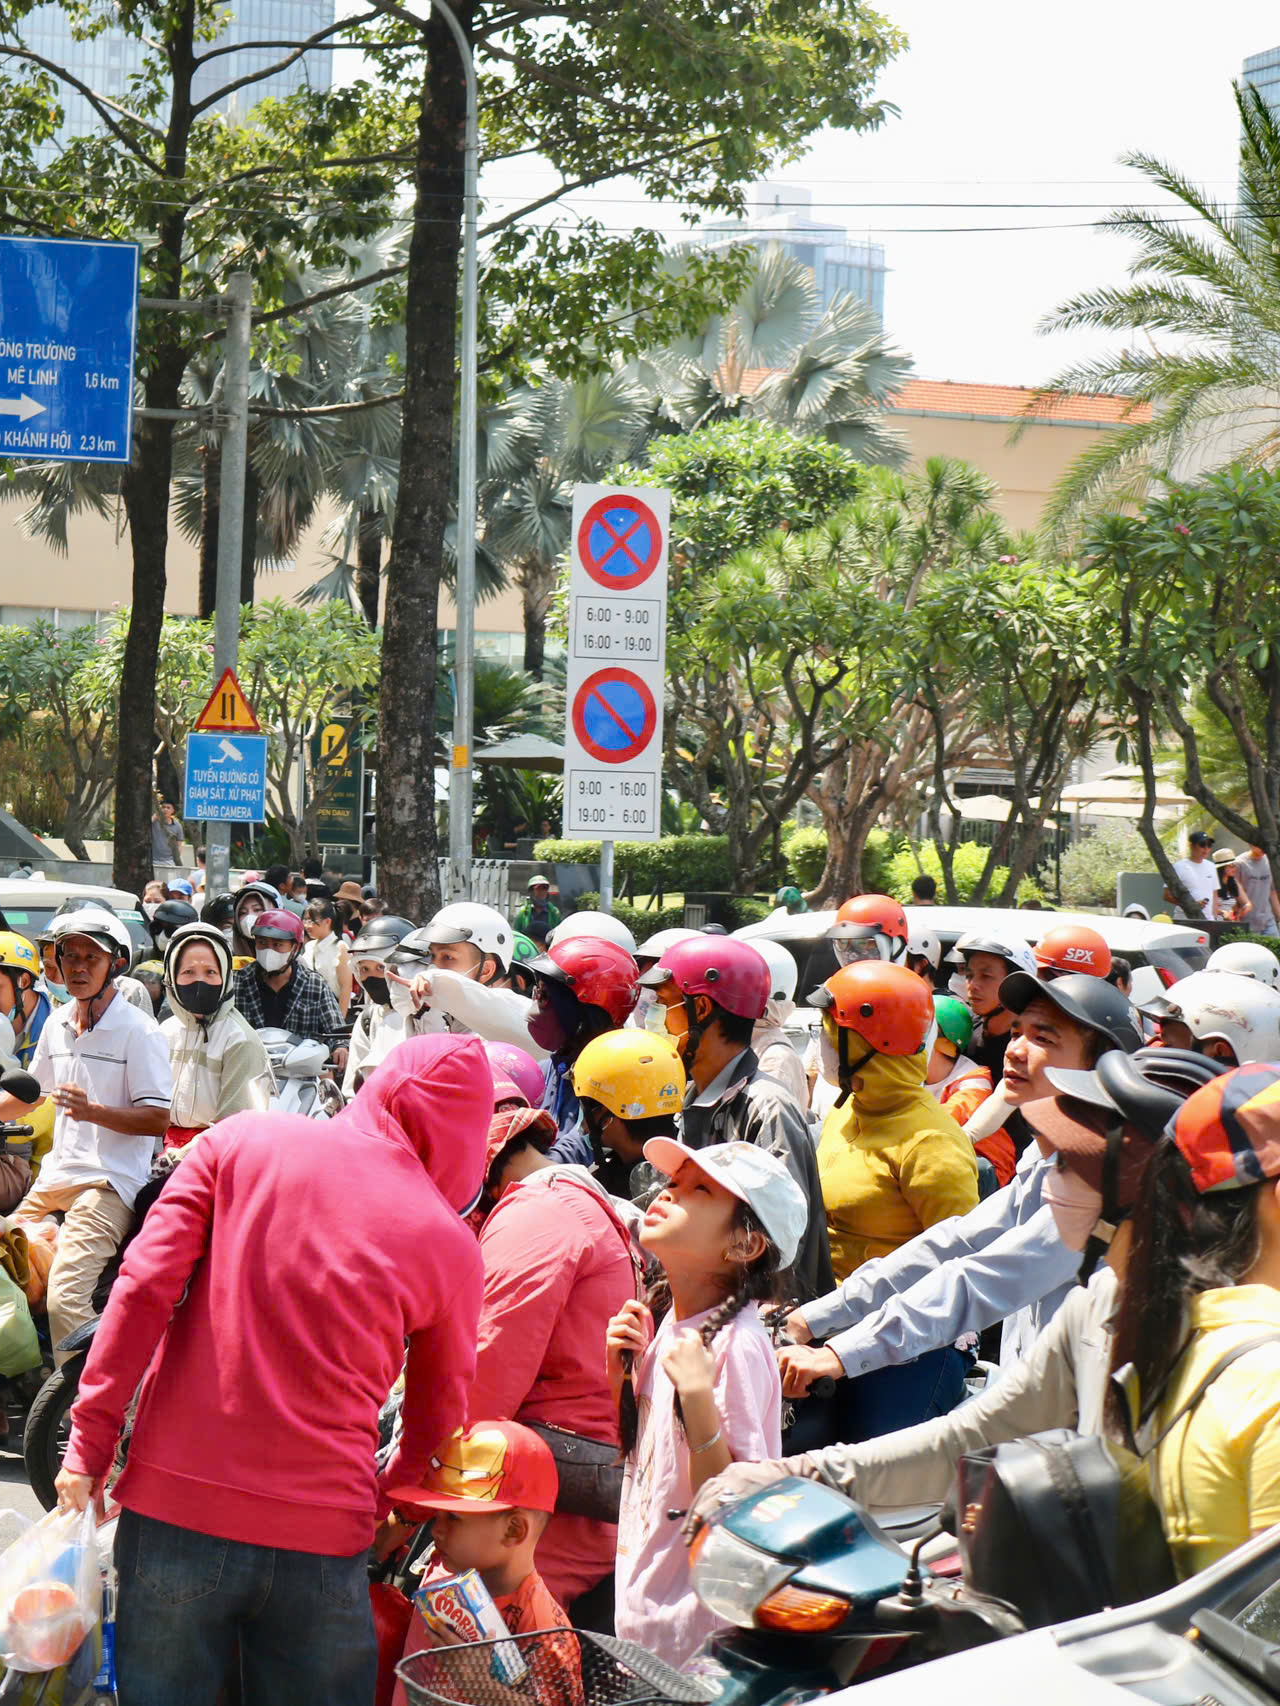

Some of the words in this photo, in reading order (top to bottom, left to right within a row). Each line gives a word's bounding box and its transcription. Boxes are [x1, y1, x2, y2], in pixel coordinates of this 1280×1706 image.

[25, 336, 77, 361] TRƯỜNG
[7, 365, 26, 384] MÊ
[28, 369, 58, 386] LINH
[84, 371, 99, 389] 1,6
[100, 373, 120, 390] km
[3, 427, 48, 449] KHÁNH
[50, 430, 72, 453] HỘI
[80, 435, 96, 451] 2,3
[97, 436, 116, 452] km
[587, 607, 611, 622] 6:00
[625, 609, 649, 624] 9:00
[583, 634, 611, 649] 16:00
[624, 636, 652, 652] 19:00
[193, 766, 218, 783] TUYẾN
[219, 768, 247, 784] ĐƯỜNG
[248, 769, 260, 785] CÓ
[189, 784, 209, 799] GIÁM
[228, 784, 240, 800] XỬ
[240, 789, 262, 805] PHẠT
[579, 780, 602, 795] 9:00
[620, 782, 647, 796] 16:00
[197, 800, 219, 816] BẰNG
[220, 805, 253, 818] CAMERA
[578, 808, 606, 823] 19:00
[623, 809, 647, 824] 6:00
[16, 942, 34, 960] be
[1065, 947, 1094, 963] SPX
